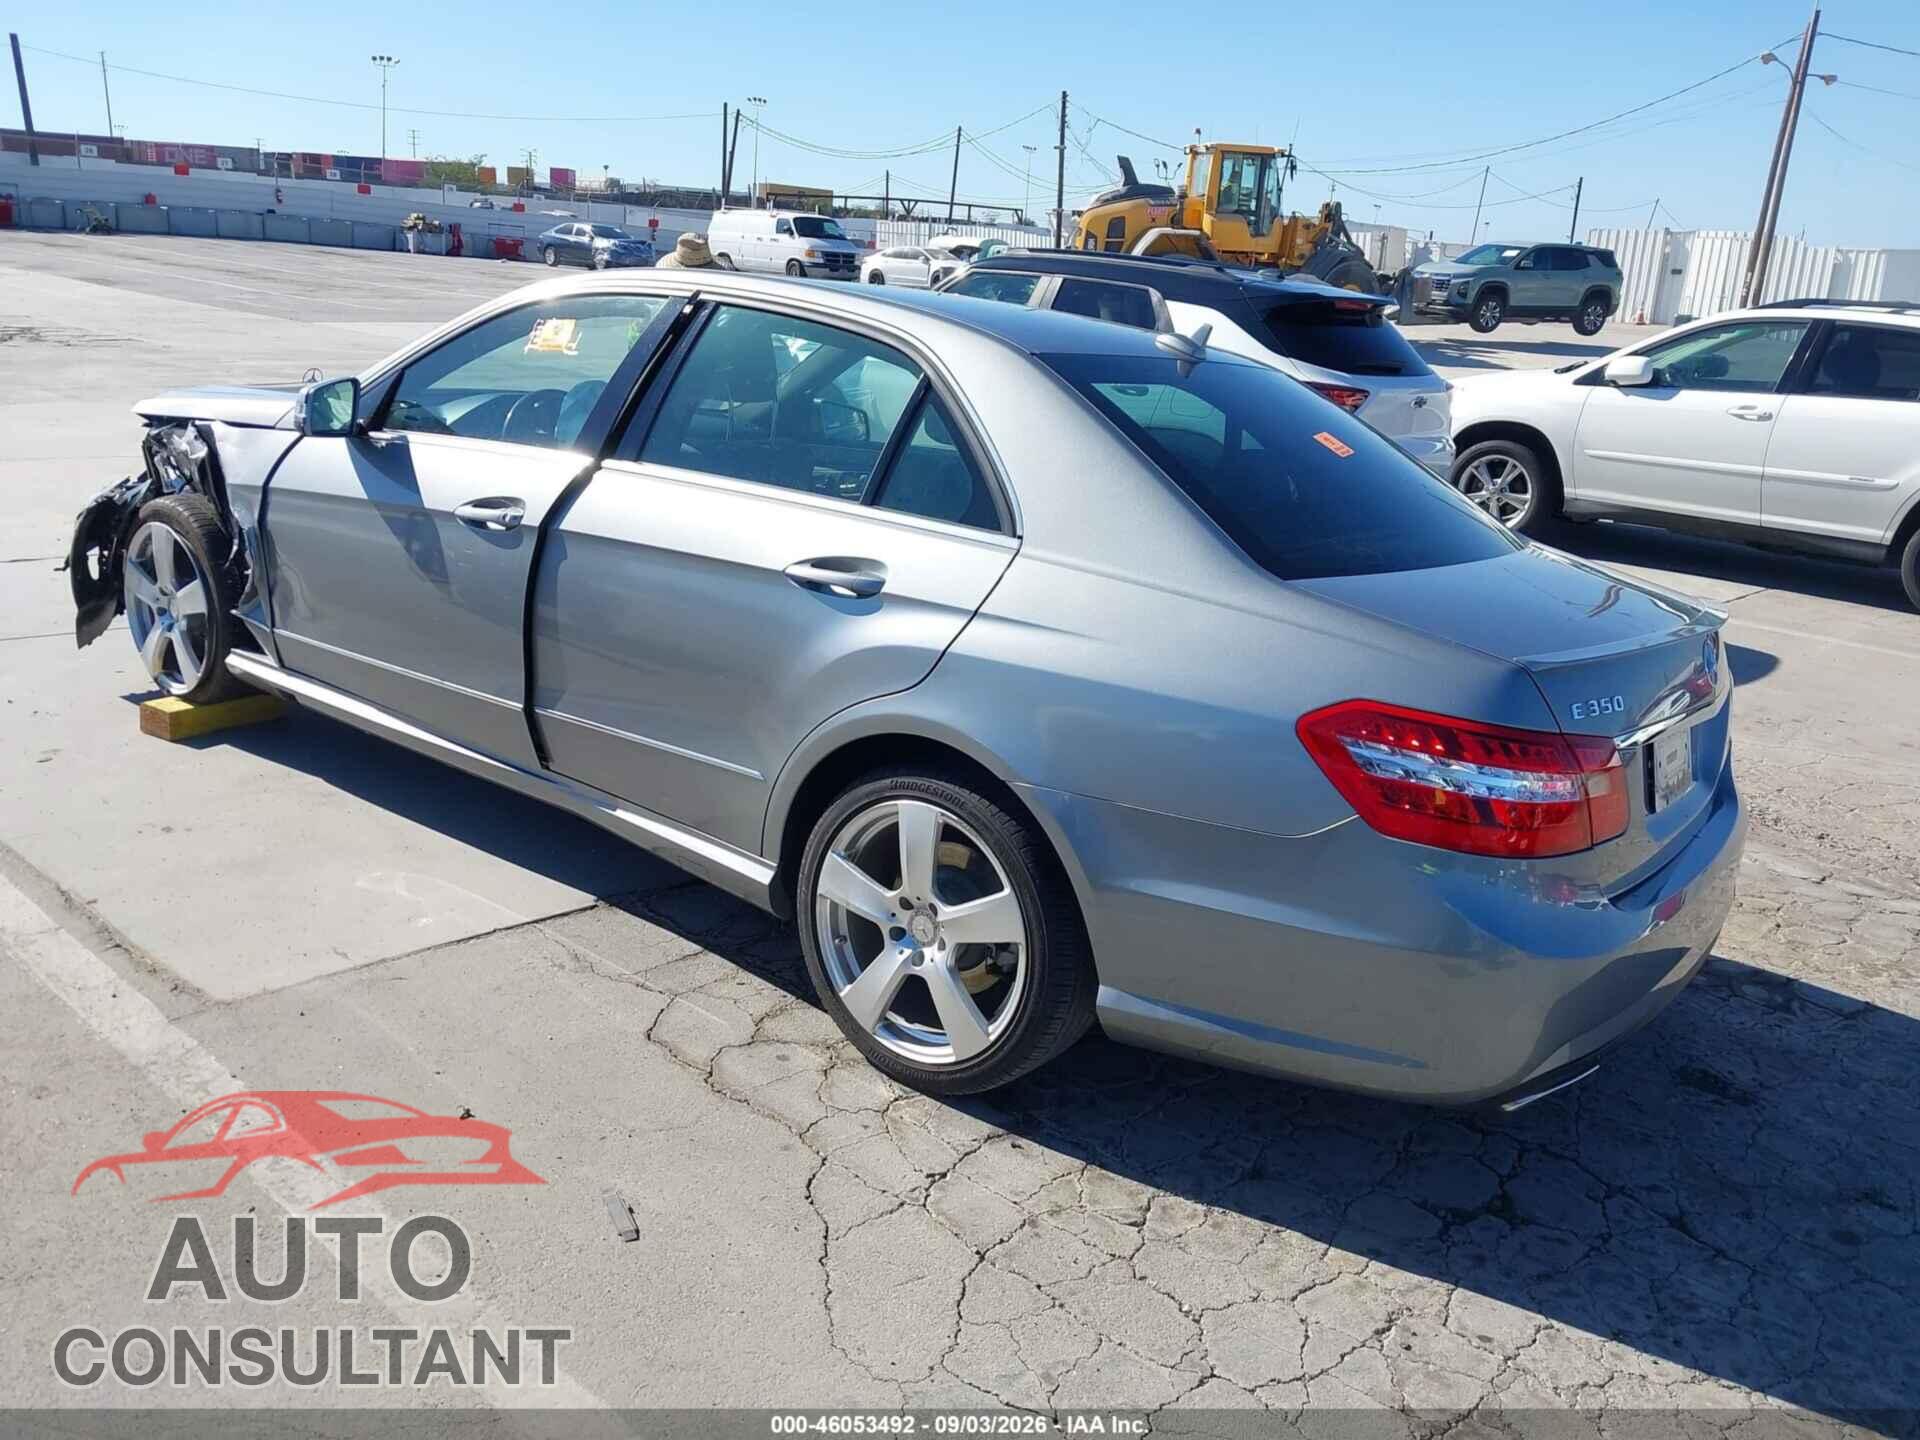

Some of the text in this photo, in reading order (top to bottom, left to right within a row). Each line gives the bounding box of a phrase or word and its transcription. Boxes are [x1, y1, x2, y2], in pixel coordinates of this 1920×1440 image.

[1571, 695, 1624, 720] E 350
[889, 779, 969, 811] BRIDGESTONE
